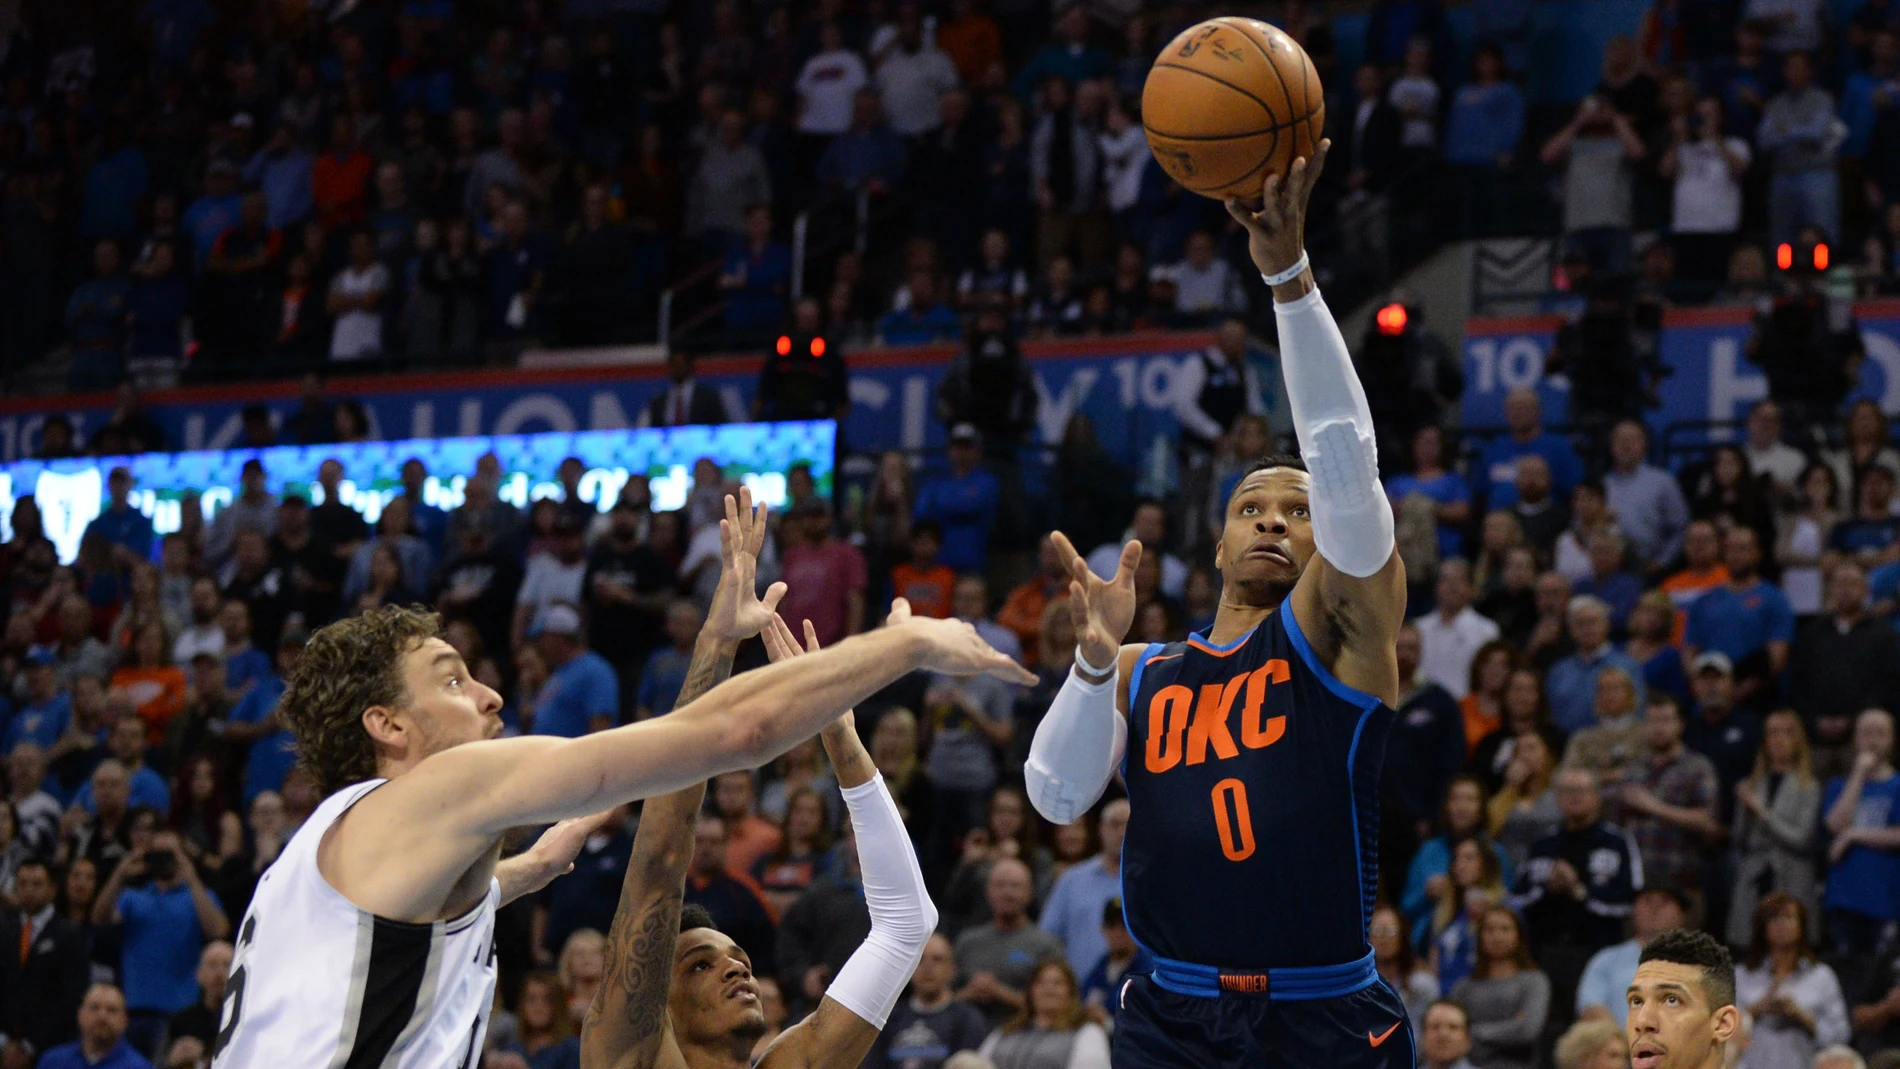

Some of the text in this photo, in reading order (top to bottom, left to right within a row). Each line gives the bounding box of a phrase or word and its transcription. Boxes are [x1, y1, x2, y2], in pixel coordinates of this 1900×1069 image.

[1145, 658, 1291, 774] OKC
[1211, 778, 1256, 862] 0
[1219, 974, 1268, 992] THUNDER
